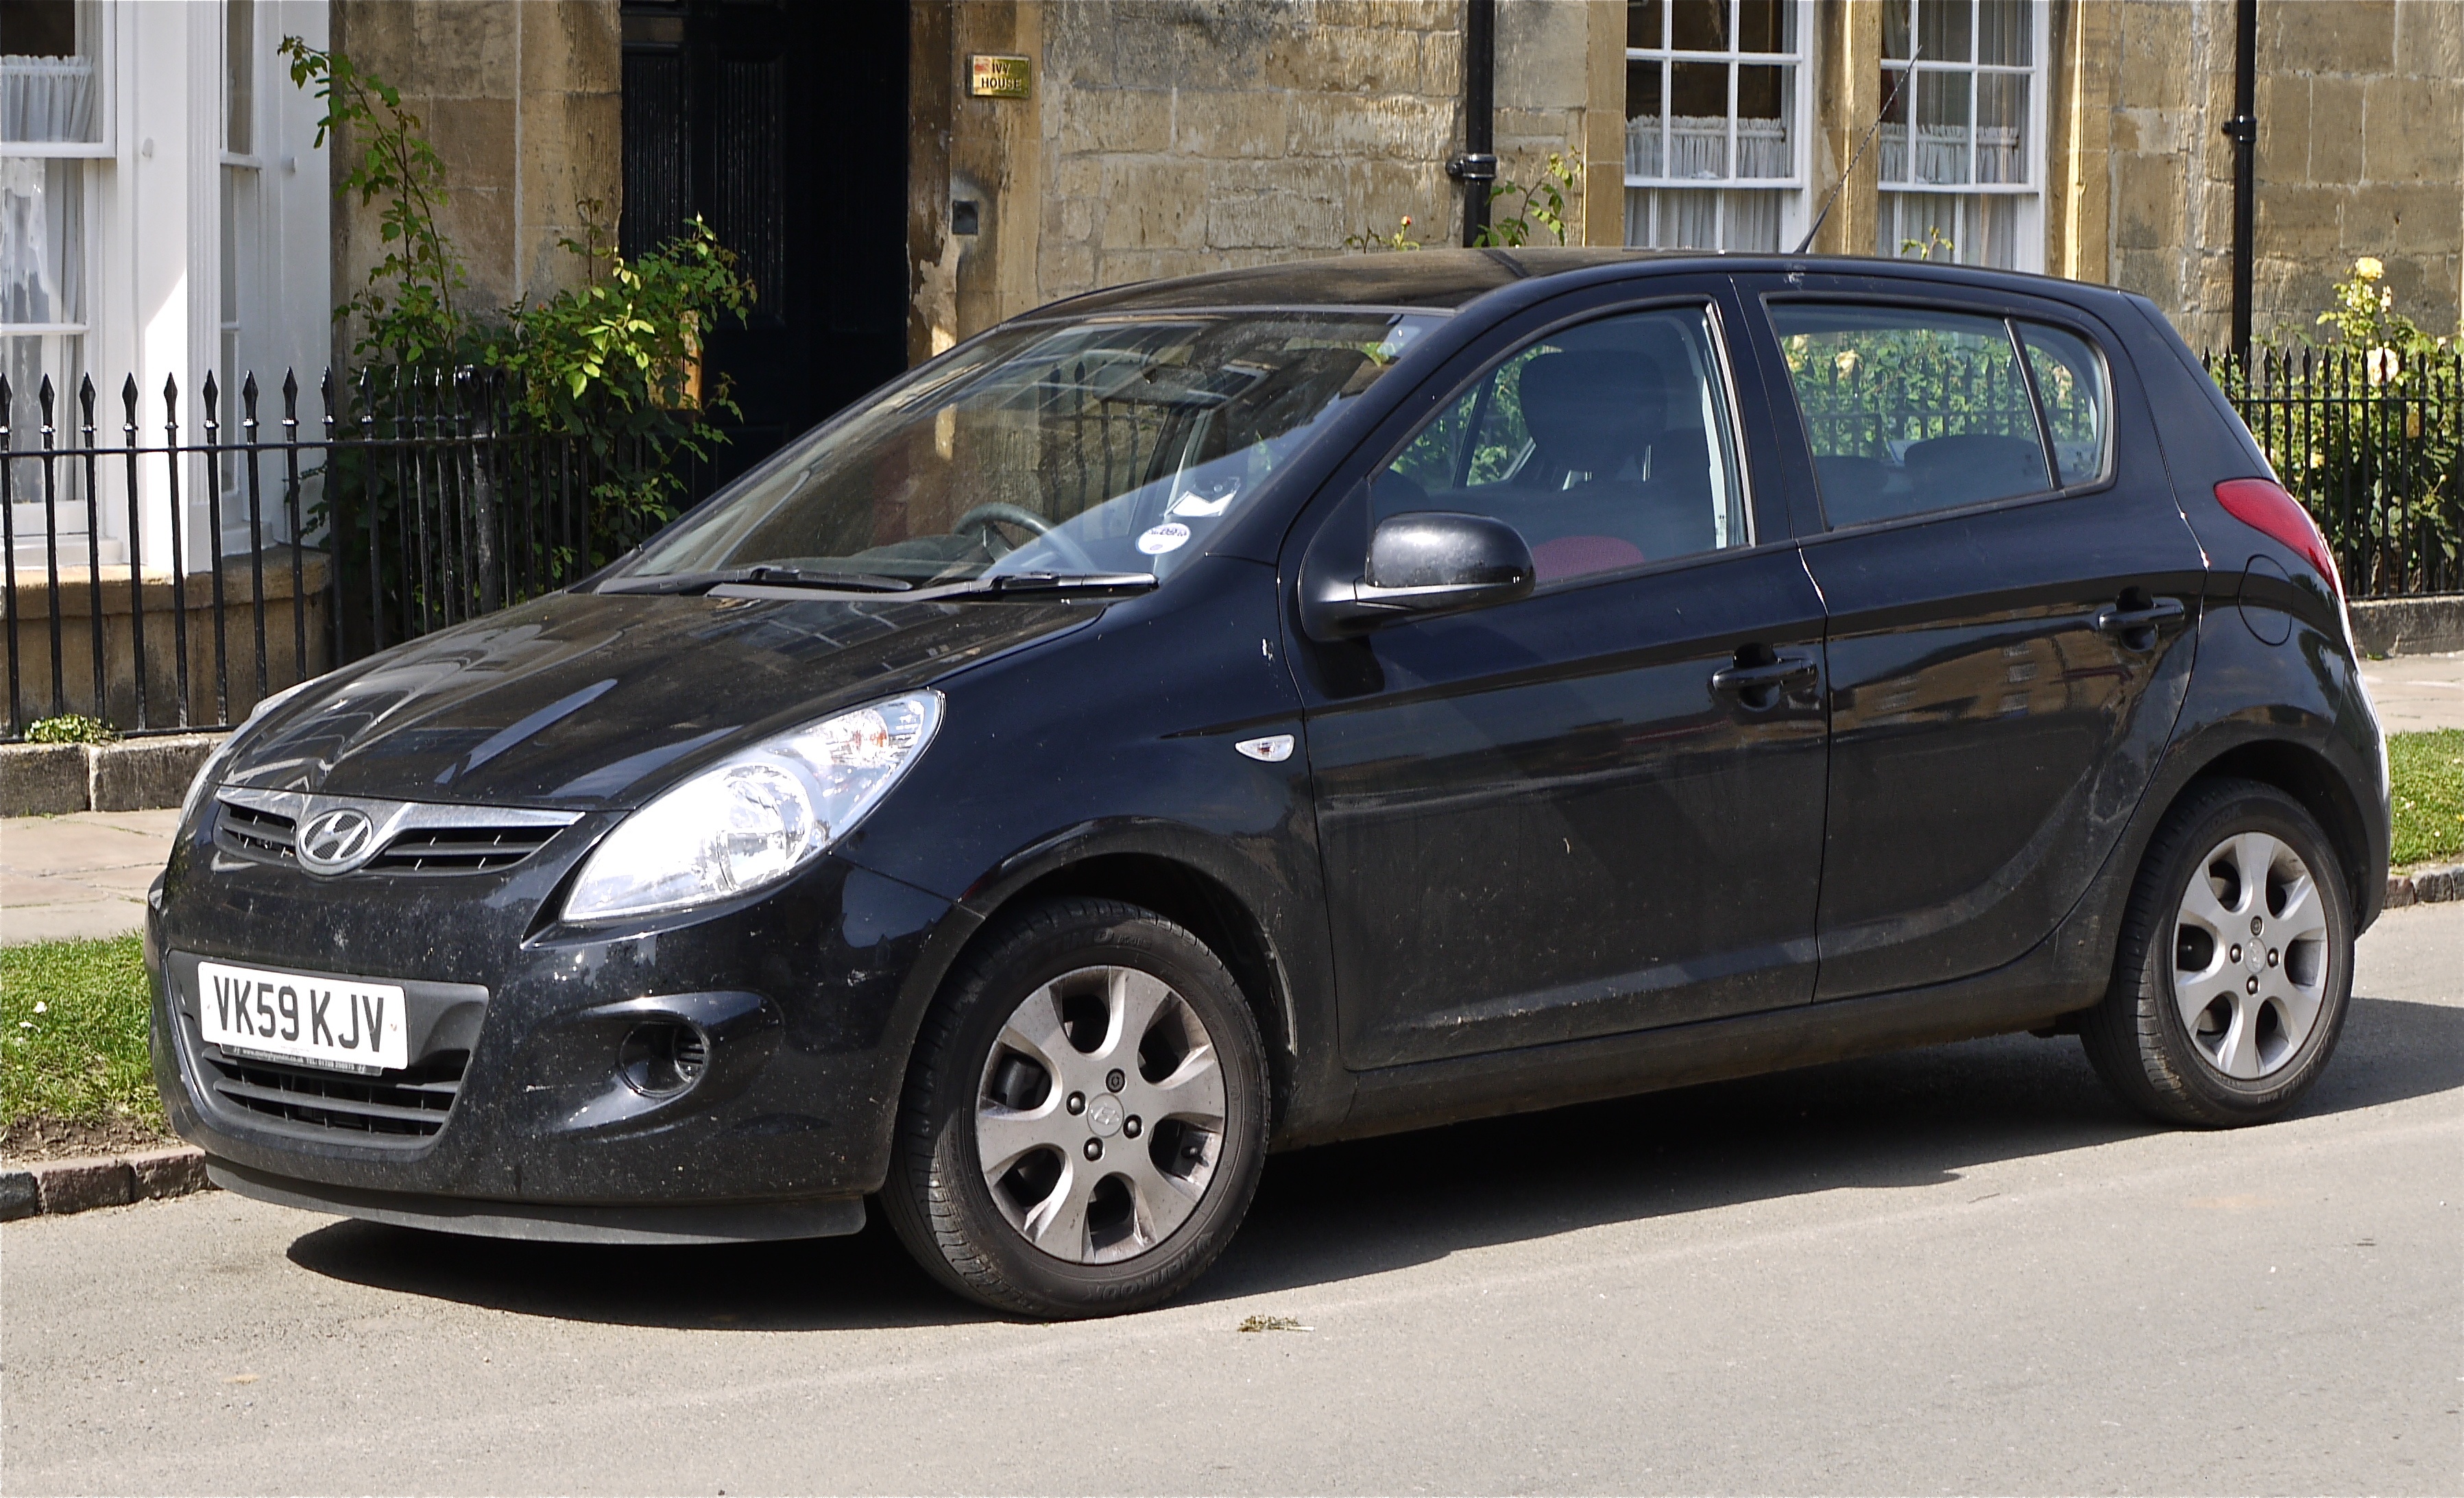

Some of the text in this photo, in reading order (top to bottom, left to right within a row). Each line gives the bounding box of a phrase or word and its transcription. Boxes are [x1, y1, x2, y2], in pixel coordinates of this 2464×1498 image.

[992, 62, 1011, 75] IVY
[981, 77, 1022, 90] HOUSE
[213, 975, 384, 1052] VK59 KJV
